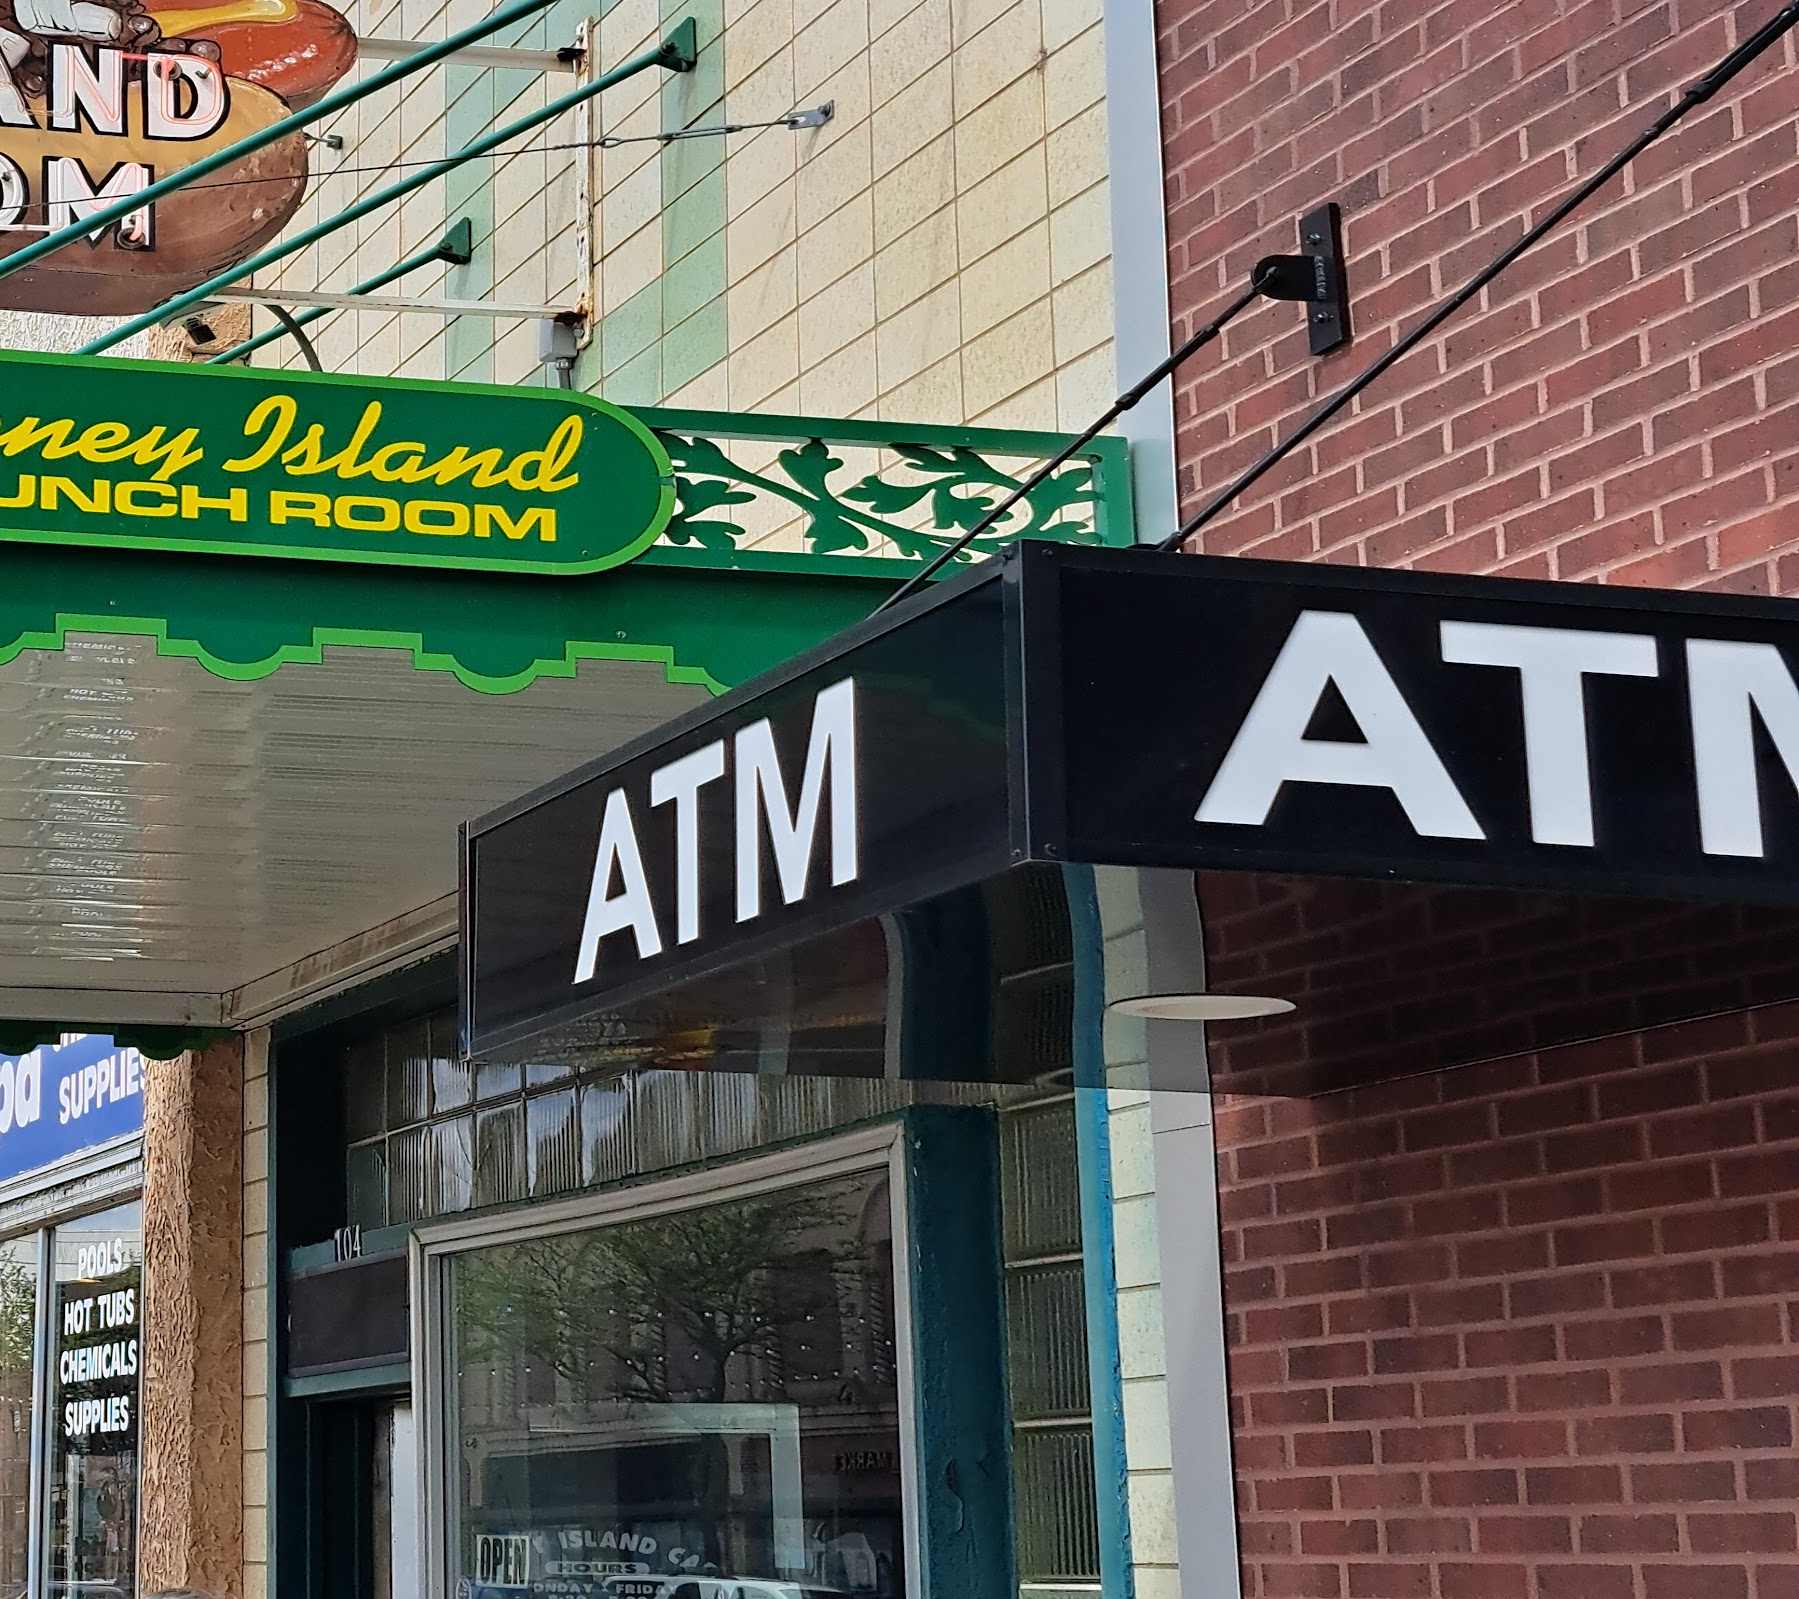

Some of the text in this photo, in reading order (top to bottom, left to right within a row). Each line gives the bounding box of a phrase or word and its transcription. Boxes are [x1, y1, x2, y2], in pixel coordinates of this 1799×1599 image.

[222, 395, 578, 492] Island
[271, 490, 556, 541] ROOM
[571, 677, 857, 984] ATM
[78, 1238, 122, 1280] POOLS
[334, 1224, 361, 1262] 104
[64, 1289, 135, 1336] HOT TUBS
[60, 1339, 137, 1385] CHEMICALS
[65, 1395, 129, 1437] SUPPLIES
[480, 1536, 527, 1586] OPEN
[558, 1529, 657, 1555] ISLAND
[534, 1583, 677, 1595] ONDAY FRIDAY
[557, 1562, 638, 1574] HOURS
